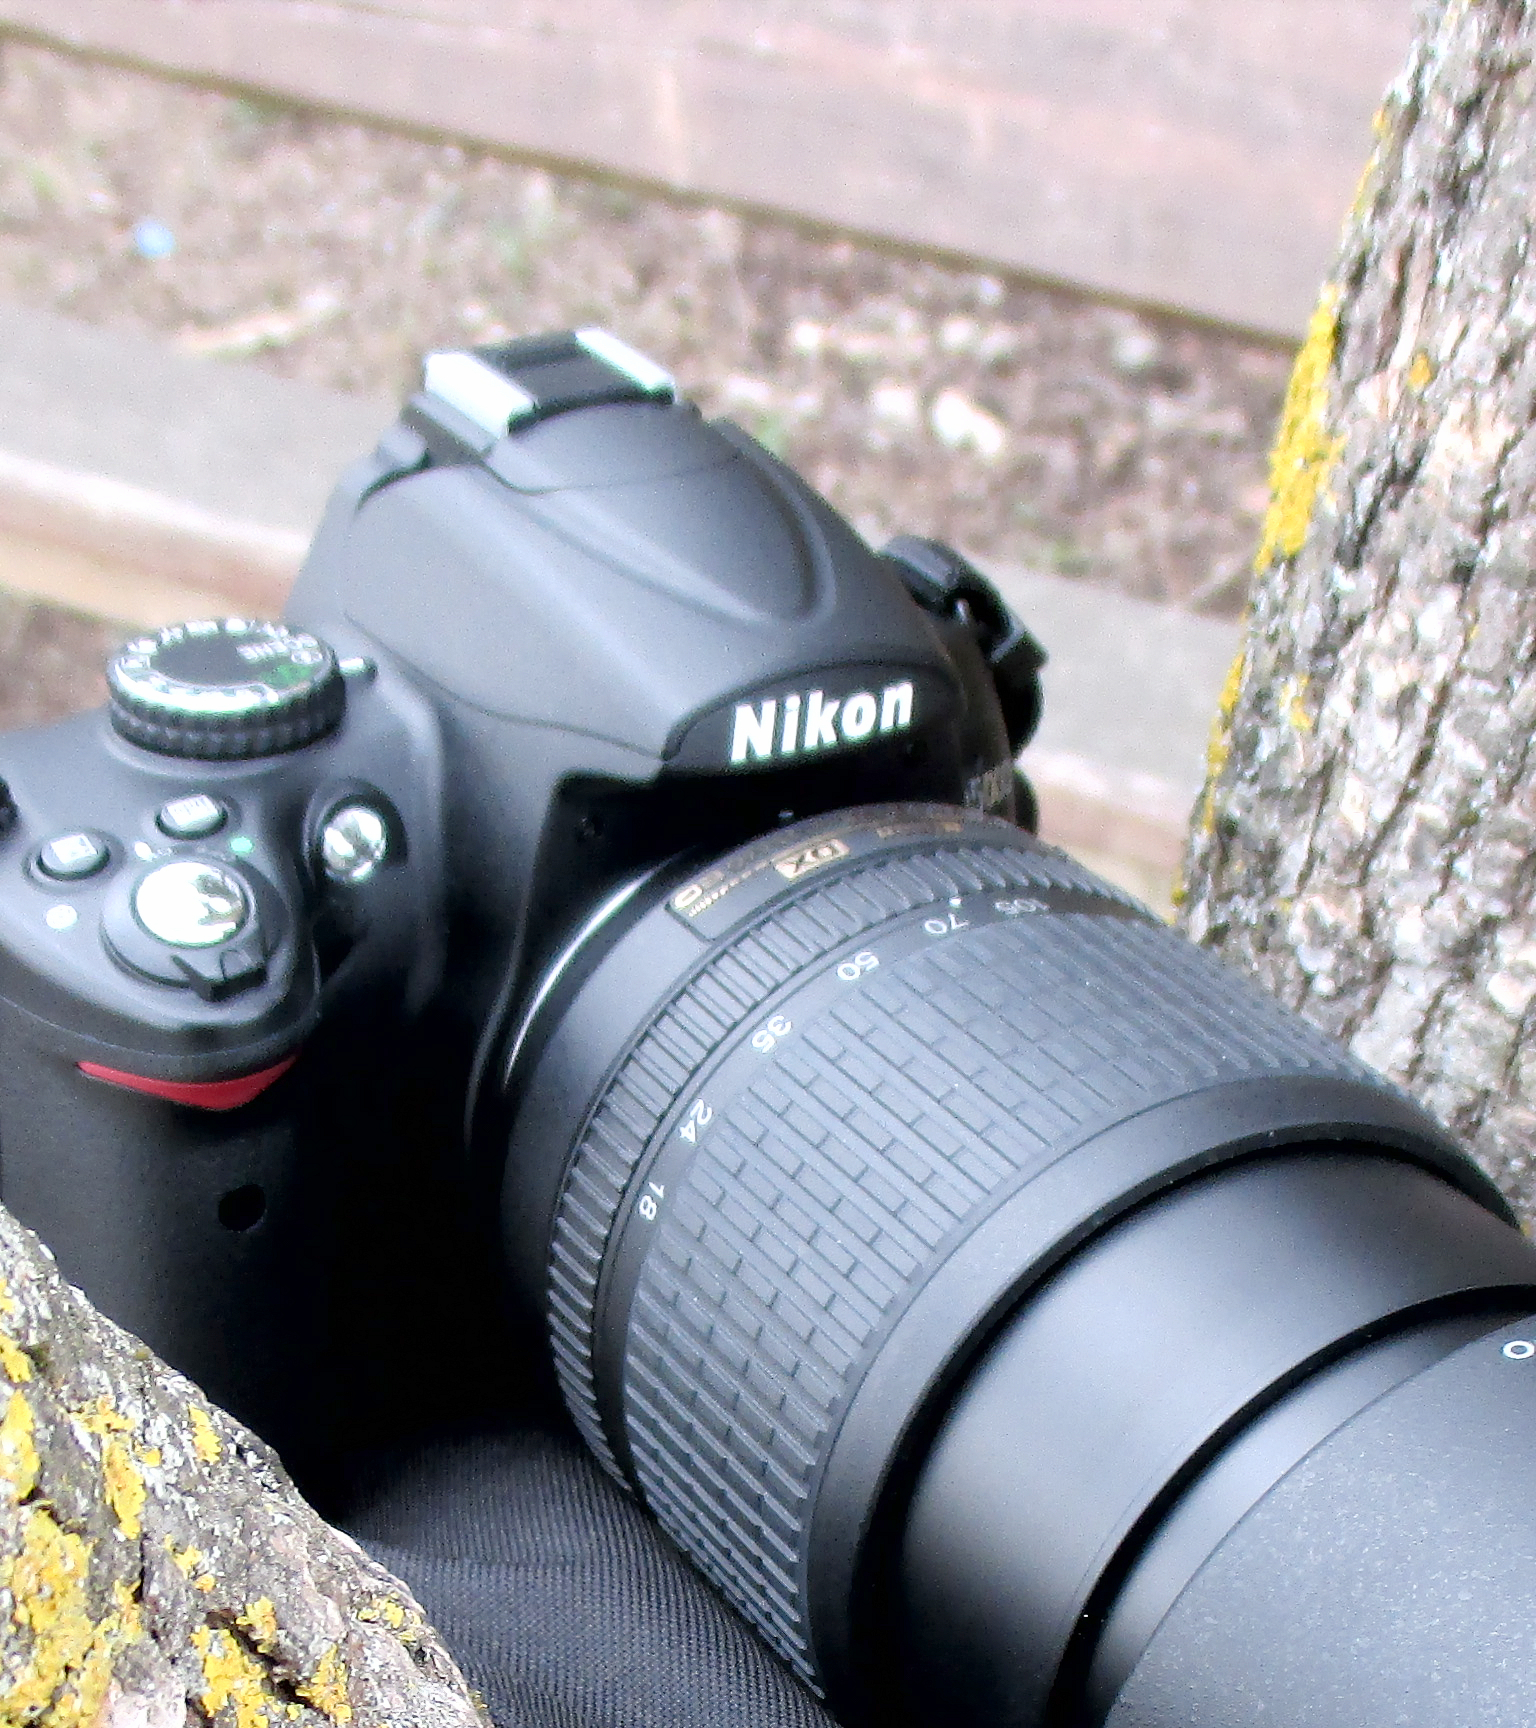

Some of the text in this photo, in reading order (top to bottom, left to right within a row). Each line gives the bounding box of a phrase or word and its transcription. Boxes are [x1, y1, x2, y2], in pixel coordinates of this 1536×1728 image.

[730, 682, 914, 763] Nikon
[924, 912, 969, 935] 70
[837, 951, 880, 981] 50
[751, 1015, 793, 1054] 35
[678, 1098, 713, 1144] 24
[638, 1180, 666, 1222] 18
